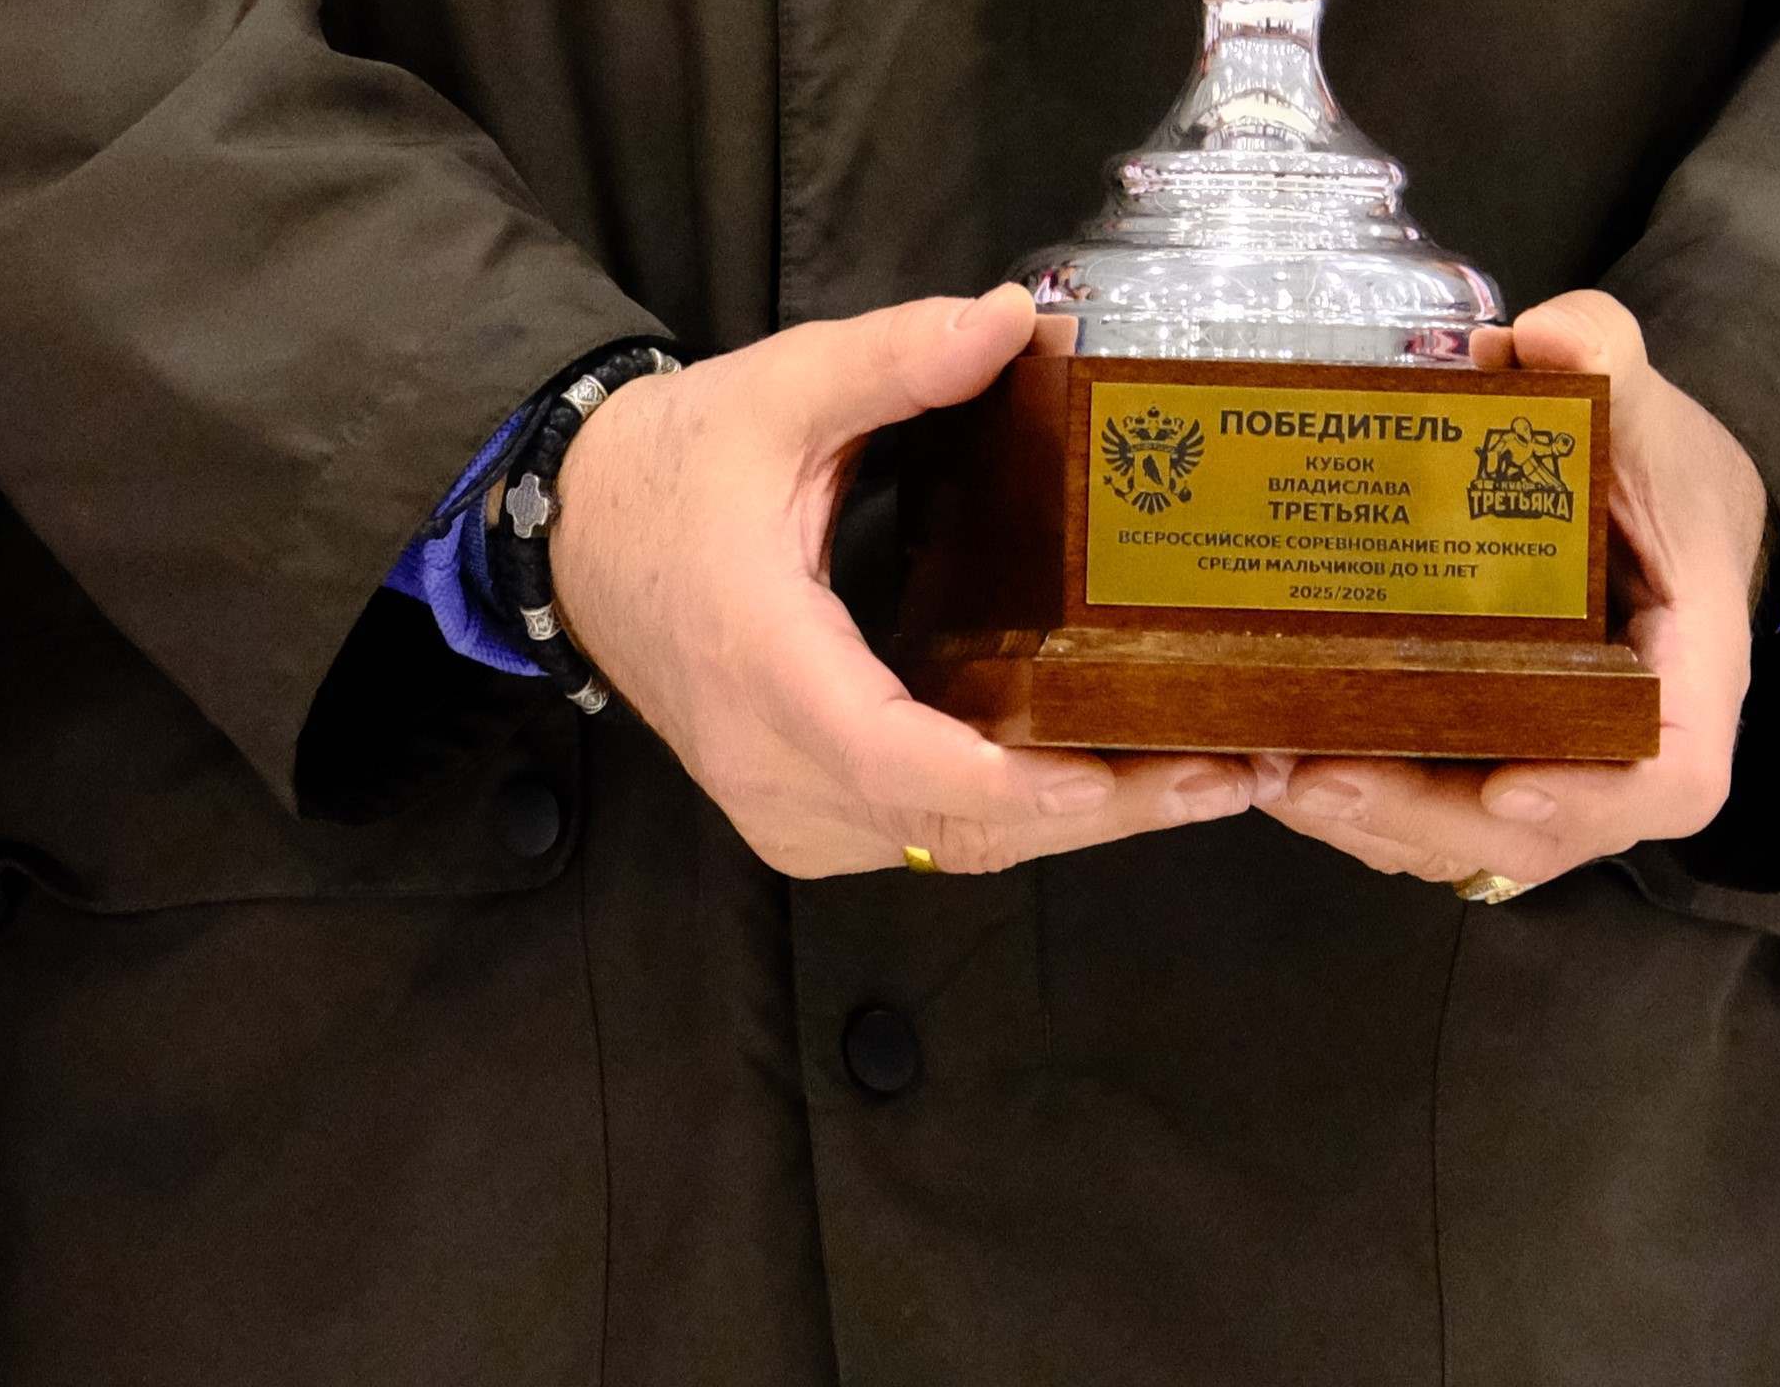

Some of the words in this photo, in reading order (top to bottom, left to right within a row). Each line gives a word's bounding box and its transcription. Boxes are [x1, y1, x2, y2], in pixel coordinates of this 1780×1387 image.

[1220, 409, 1464, 444] ПОБЕДИТЕЛЬ
[1305, 455, 1375, 473] КУБОК
[1268, 477, 1412, 497] ВЛАДИСЛАВА
[1268, 500, 1411, 525] ТРЕТЬЯКА
[1470, 490, 1570, 519] ТРЕТЬЯКА
[1117, 529, 1282, 549] ВСЕРОССИЙСКОЕ
[1285, 534, 1440, 555] СОРЕВНОВАНИЕ
[1443, 540, 1472, 555] ПО
[1475, 540, 1558, 558] ХОККЕЮ
[1197, 555, 1261, 573] СРЕДИ
[1265, 557, 1386, 576] МАЛЬЧИКОВ
[1388, 562, 1419, 578] ДО
[1423, 563, 1440, 577] 11
[1443, 563, 1479, 578] ЛЕТ
[1288, 584, 1388, 602] 2025/2026
